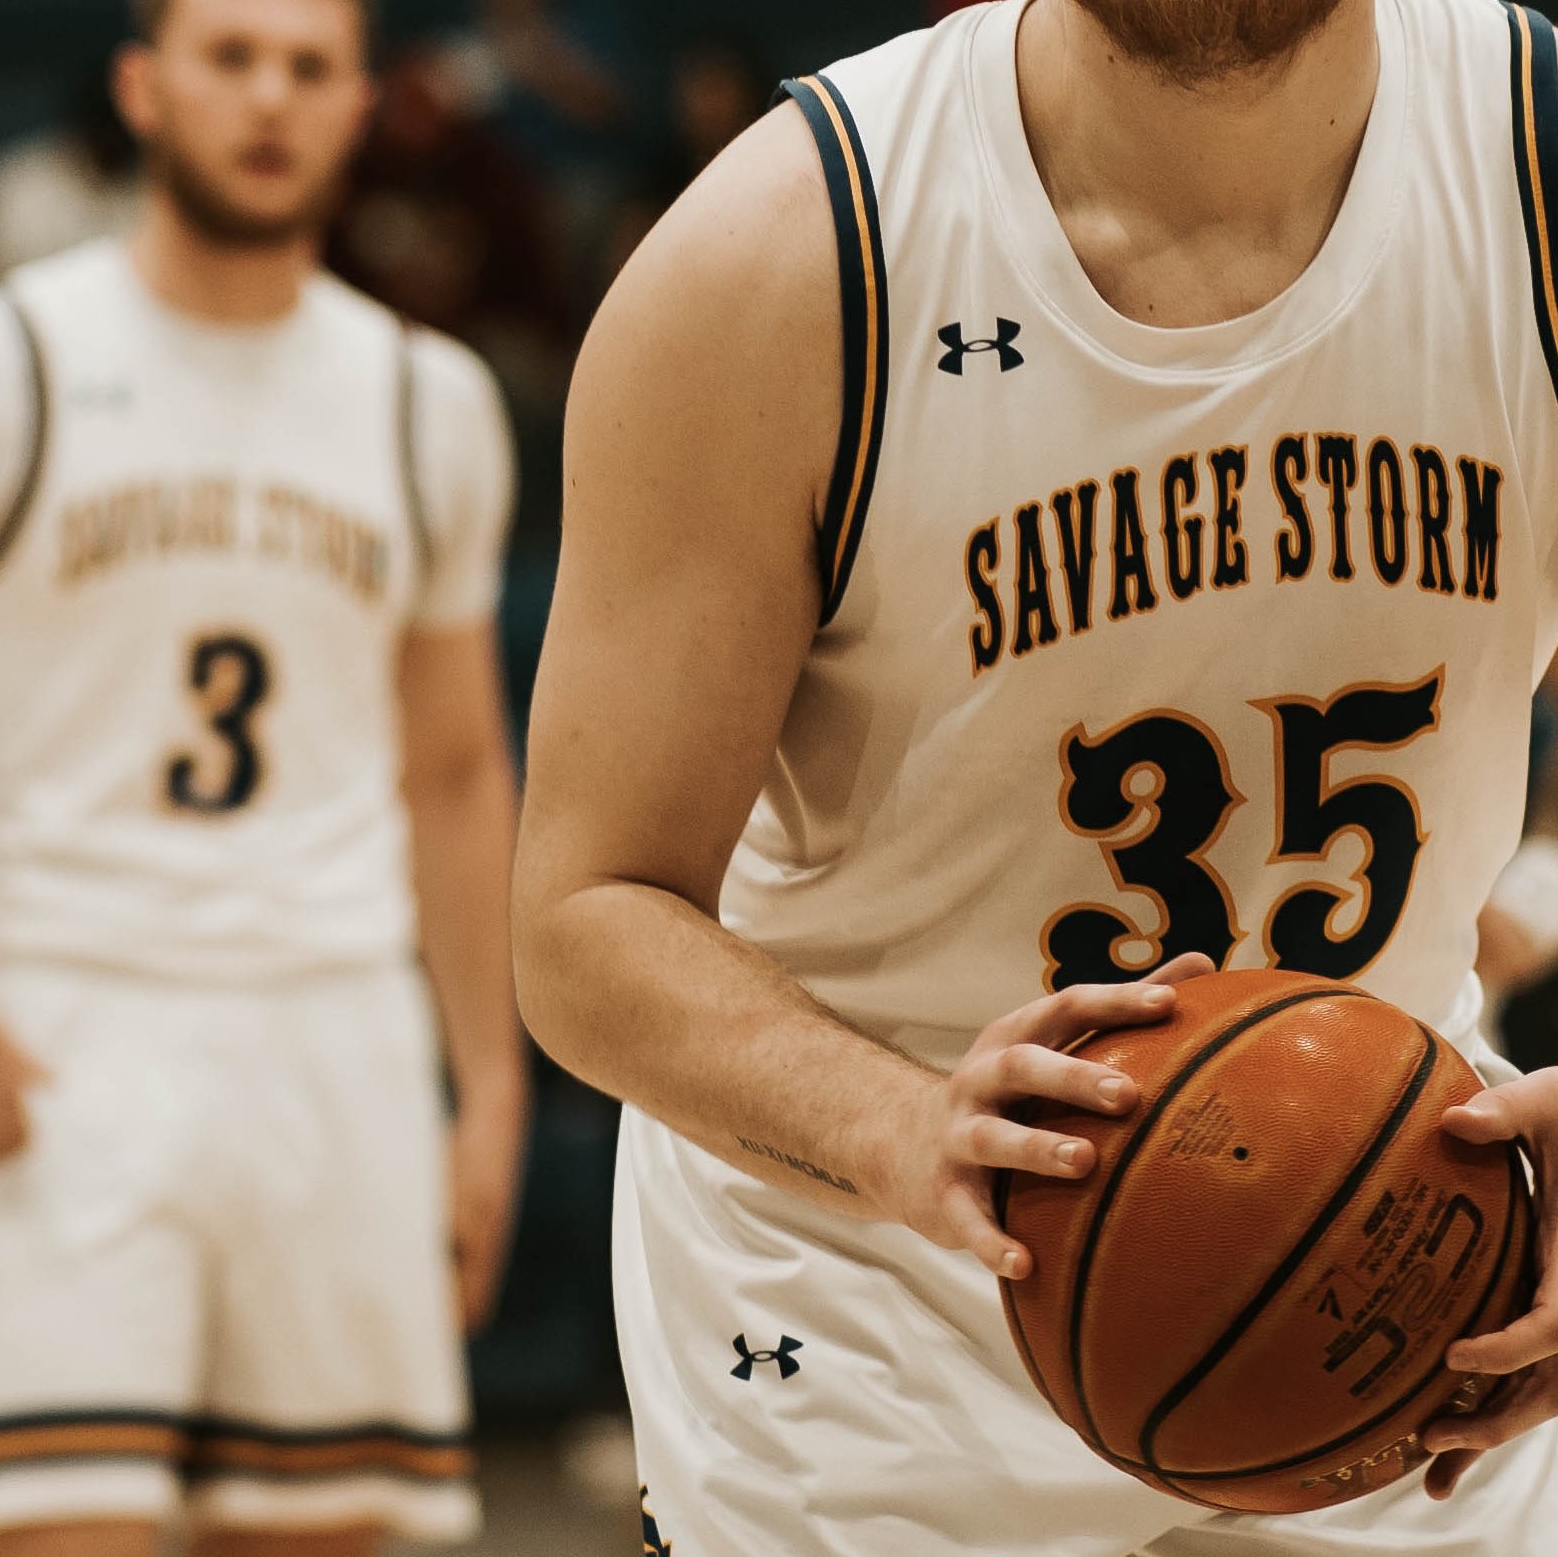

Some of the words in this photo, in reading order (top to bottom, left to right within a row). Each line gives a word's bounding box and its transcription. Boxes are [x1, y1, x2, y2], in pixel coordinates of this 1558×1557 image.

[964, 443, 1250, 678] SAVAGE
[1270, 432, 1504, 603] STORM
[165, 631, 271, 816] 3
[1040, 663, 1446, 995] 35
